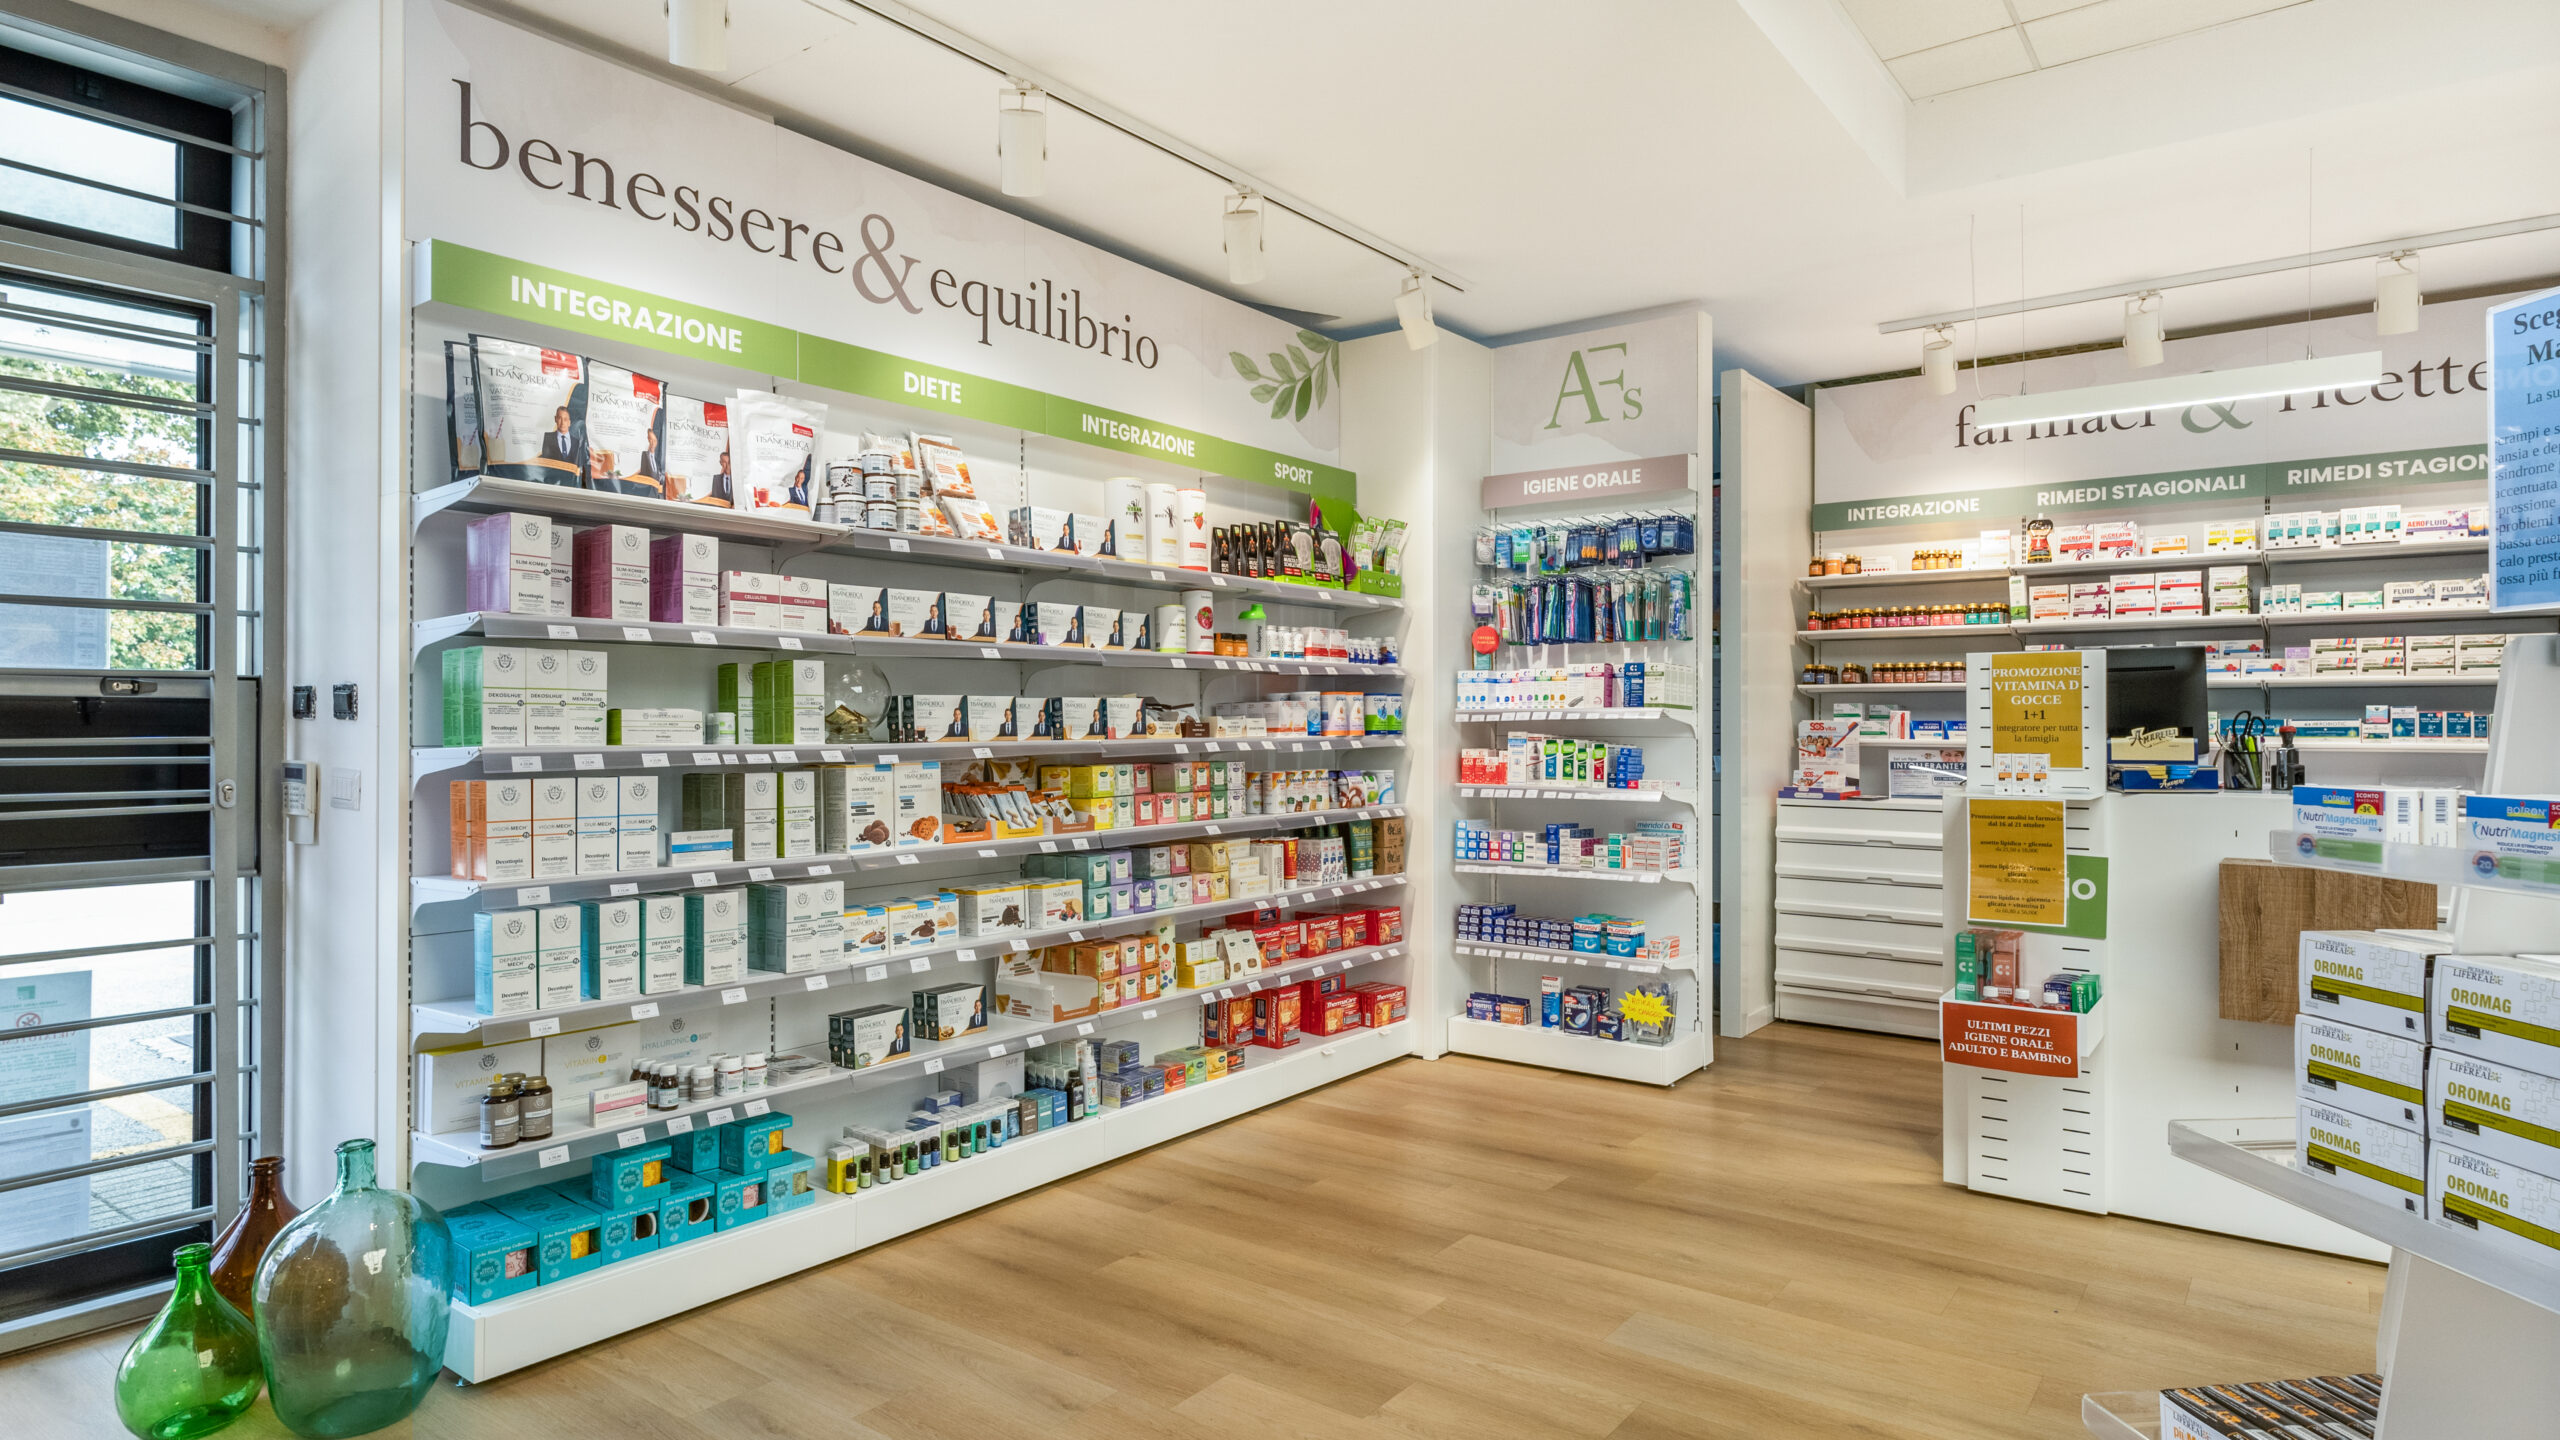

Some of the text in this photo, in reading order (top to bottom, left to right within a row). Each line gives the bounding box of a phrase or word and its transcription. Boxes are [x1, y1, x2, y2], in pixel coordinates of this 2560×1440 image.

[451, 78, 1160, 370] benessere & equilibrio
[511, 276, 743, 355] INTEGRAZIONE
[2513, 308, 2560, 336] Sce
[904, 371, 962, 404] DIETE
[2526, 391, 2543, 405] La
[1082, 413, 1195, 458] INTEGRAZIONE
[1274, 462, 1313, 486] SPORT
[1523, 468, 1642, 496] IGIENE ORALE
[2287, 463, 2371, 485] RIMEDI
[2037, 474, 2246, 506] RIMEDI STAGIONALI
[1847, 497, 1980, 522] INTEGRAZIONE
[2407, 519, 2448, 528] AEROFLUID
[2393, 587, 2415, 595] FLUID
[2442, 585, 2464, 593] FLUID
[1992, 667, 2081, 678] PROMOZIONE
[1995, 680, 2079, 691] VITAMINA D
[2011, 695, 2062, 705] GOCCE
[2024, 710, 2046, 720] 1+1
[1996, 724, 2040, 733] integratore
[2043, 725, 2056, 733] per
[2014, 734, 2059, 743] la famiglia
[2067, 877, 2097, 901] O
[1310, 919, 1339, 930] ThermaCare
[1342, 913, 1366, 922] ThermaCare
[1379, 910, 1400, 918] ThermaCare
[2314, 959, 2364, 981] OROMAG
[1327, 996, 1357, 1008] ThermaCare
[1377, 990, 1405, 1001] ThermaCare
[2451, 987, 2512, 1014] OROMAG
[1967, 1019, 2051, 1038] ULTIMI PEZZI
[642, 1038, 690, 1051] HYALURONIC
[1964, 1031, 2054, 1051] IGIENE ORALE
[1949, 1041, 2072, 1066] ADULTO E BAMBINO
[2310, 1043, 2361, 1068] OROMAG
[2447, 1082, 2511, 1112] OROMAG
[2310, 1126, 2361, 1155] OROMAG
[2447, 1174, 2510, 1209] OROMAG
